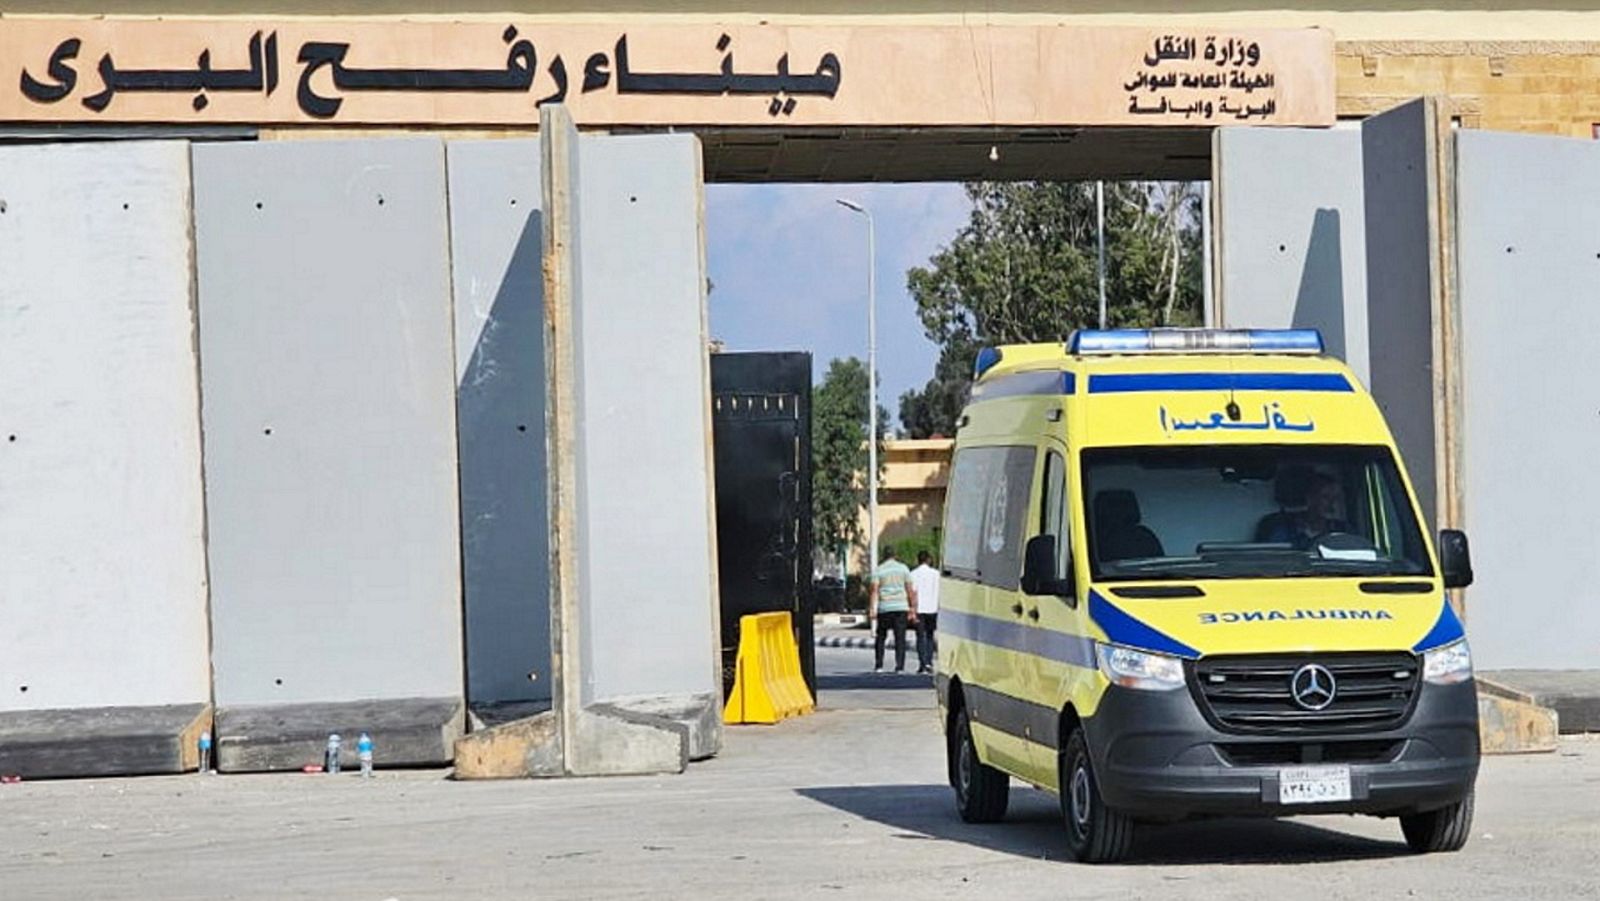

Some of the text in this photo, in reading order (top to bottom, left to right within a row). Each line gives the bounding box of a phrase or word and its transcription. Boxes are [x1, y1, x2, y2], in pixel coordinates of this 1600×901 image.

[1143, 35, 1261, 67] وزارة النقل
[296, 24, 568, 118] رفح
[582, 33, 841, 116] ميناء
[1180, 72, 1227, 89] العامة
[1229, 70, 1275, 93] الهيئة
[1218, 97, 1276, 119] البرية
